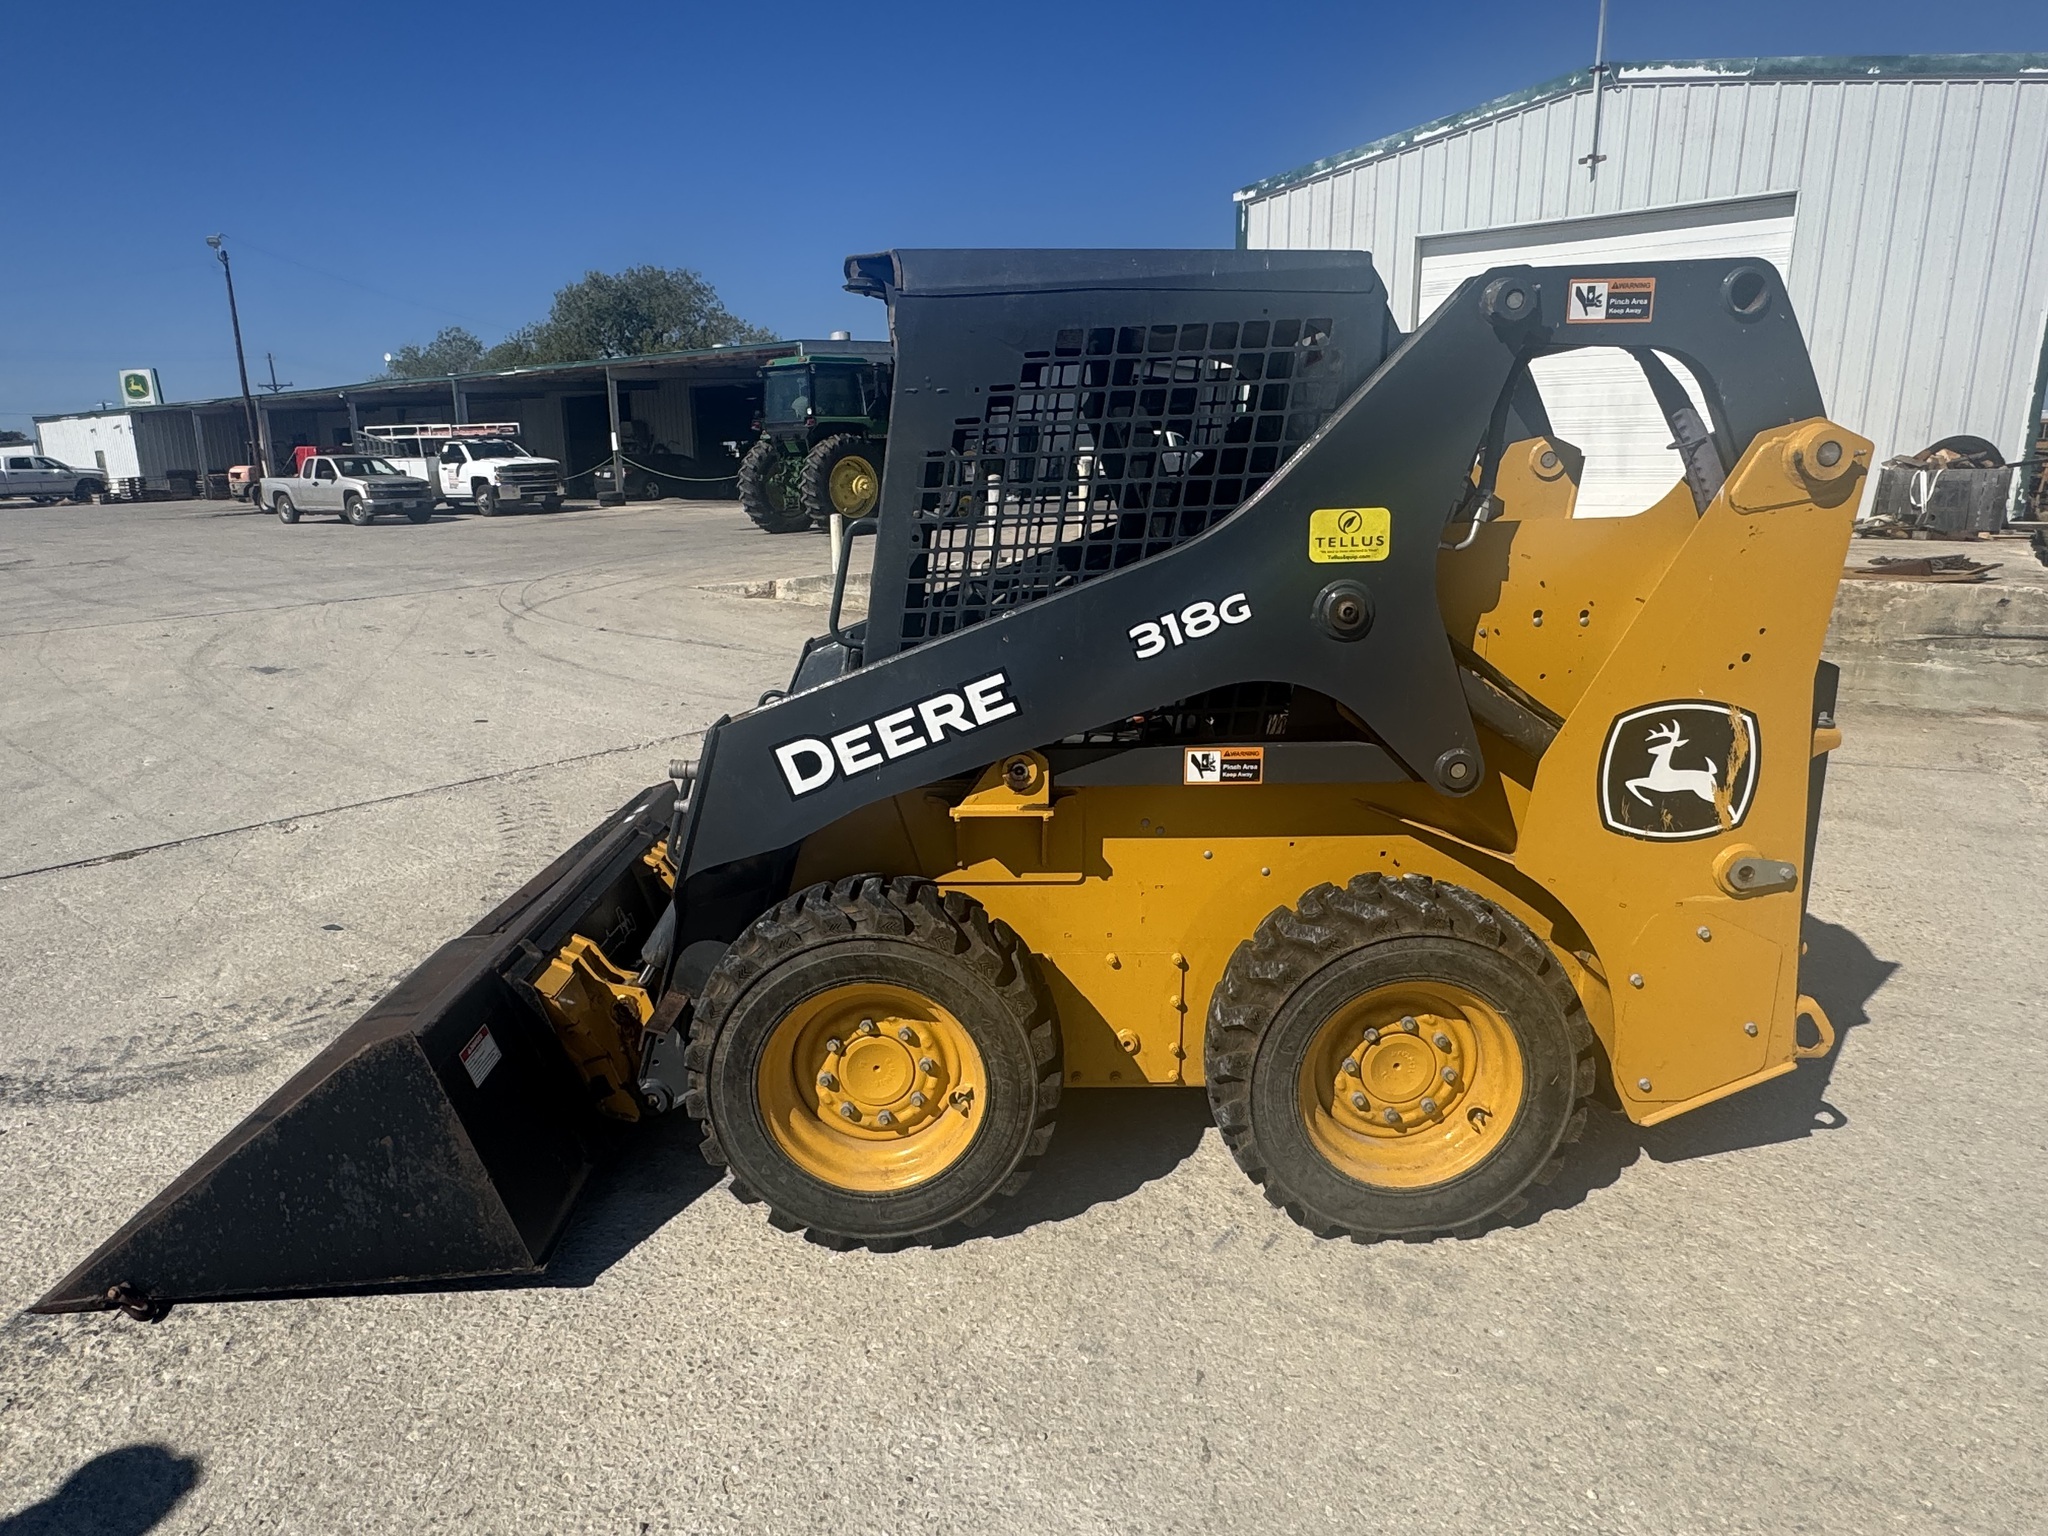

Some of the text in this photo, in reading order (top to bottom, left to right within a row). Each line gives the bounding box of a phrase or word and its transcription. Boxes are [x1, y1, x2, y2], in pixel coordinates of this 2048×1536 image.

[1315, 535, 1385, 548] TELLUS
[1129, 592, 1252, 659] 318G
[775, 672, 1017, 796] DEERE
